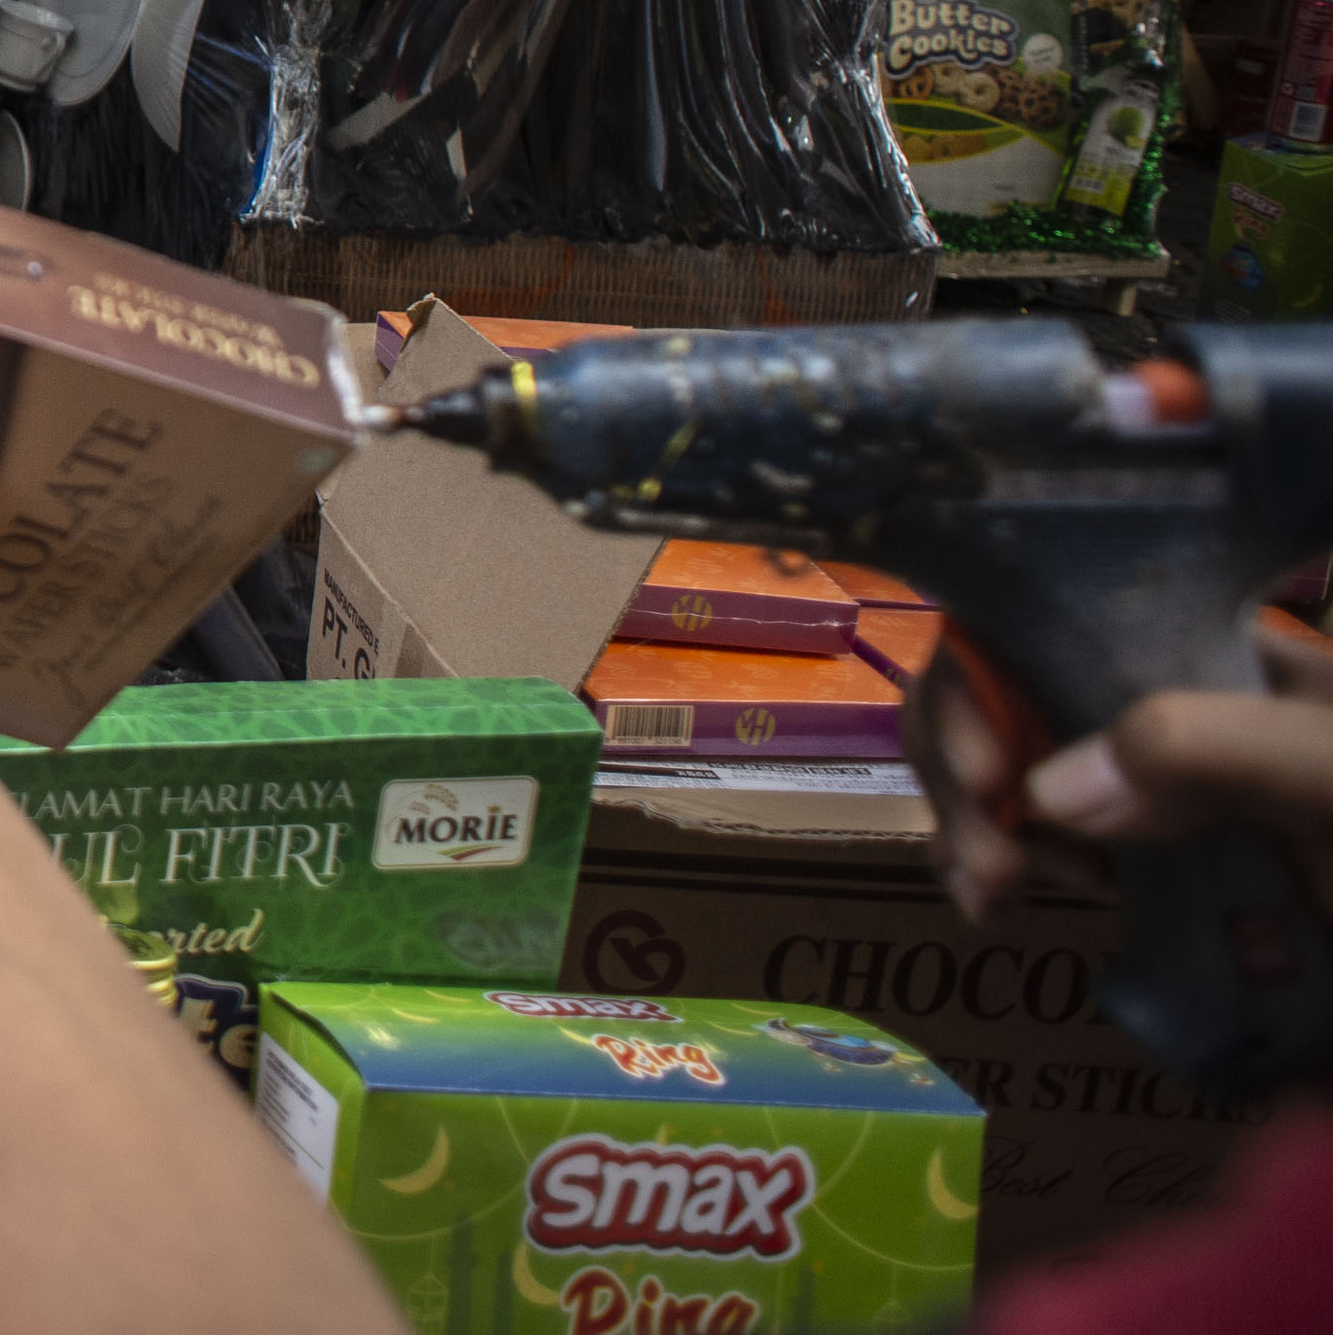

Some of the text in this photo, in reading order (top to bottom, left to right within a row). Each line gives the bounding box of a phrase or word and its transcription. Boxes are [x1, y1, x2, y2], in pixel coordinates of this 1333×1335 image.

[889, 30, 1009, 70] Cookies
[67, 284, 321, 391] CHOCOLATE
[322, 595, 348, 670] PT.
[324, 568, 374, 647] MANUFACTURED
[16, 779, 355, 819] LAMAT HARI RAYA
[394, 803, 518, 845] MORIE
[50, 816, 351, 888] UL FITRI
[153, 908, 265, 954] orted
[763, 934, 1118, 1026] CHOCO
[593, 1033, 725, 1085] Ring
[1030, 1061, 1263, 1129] STIC
